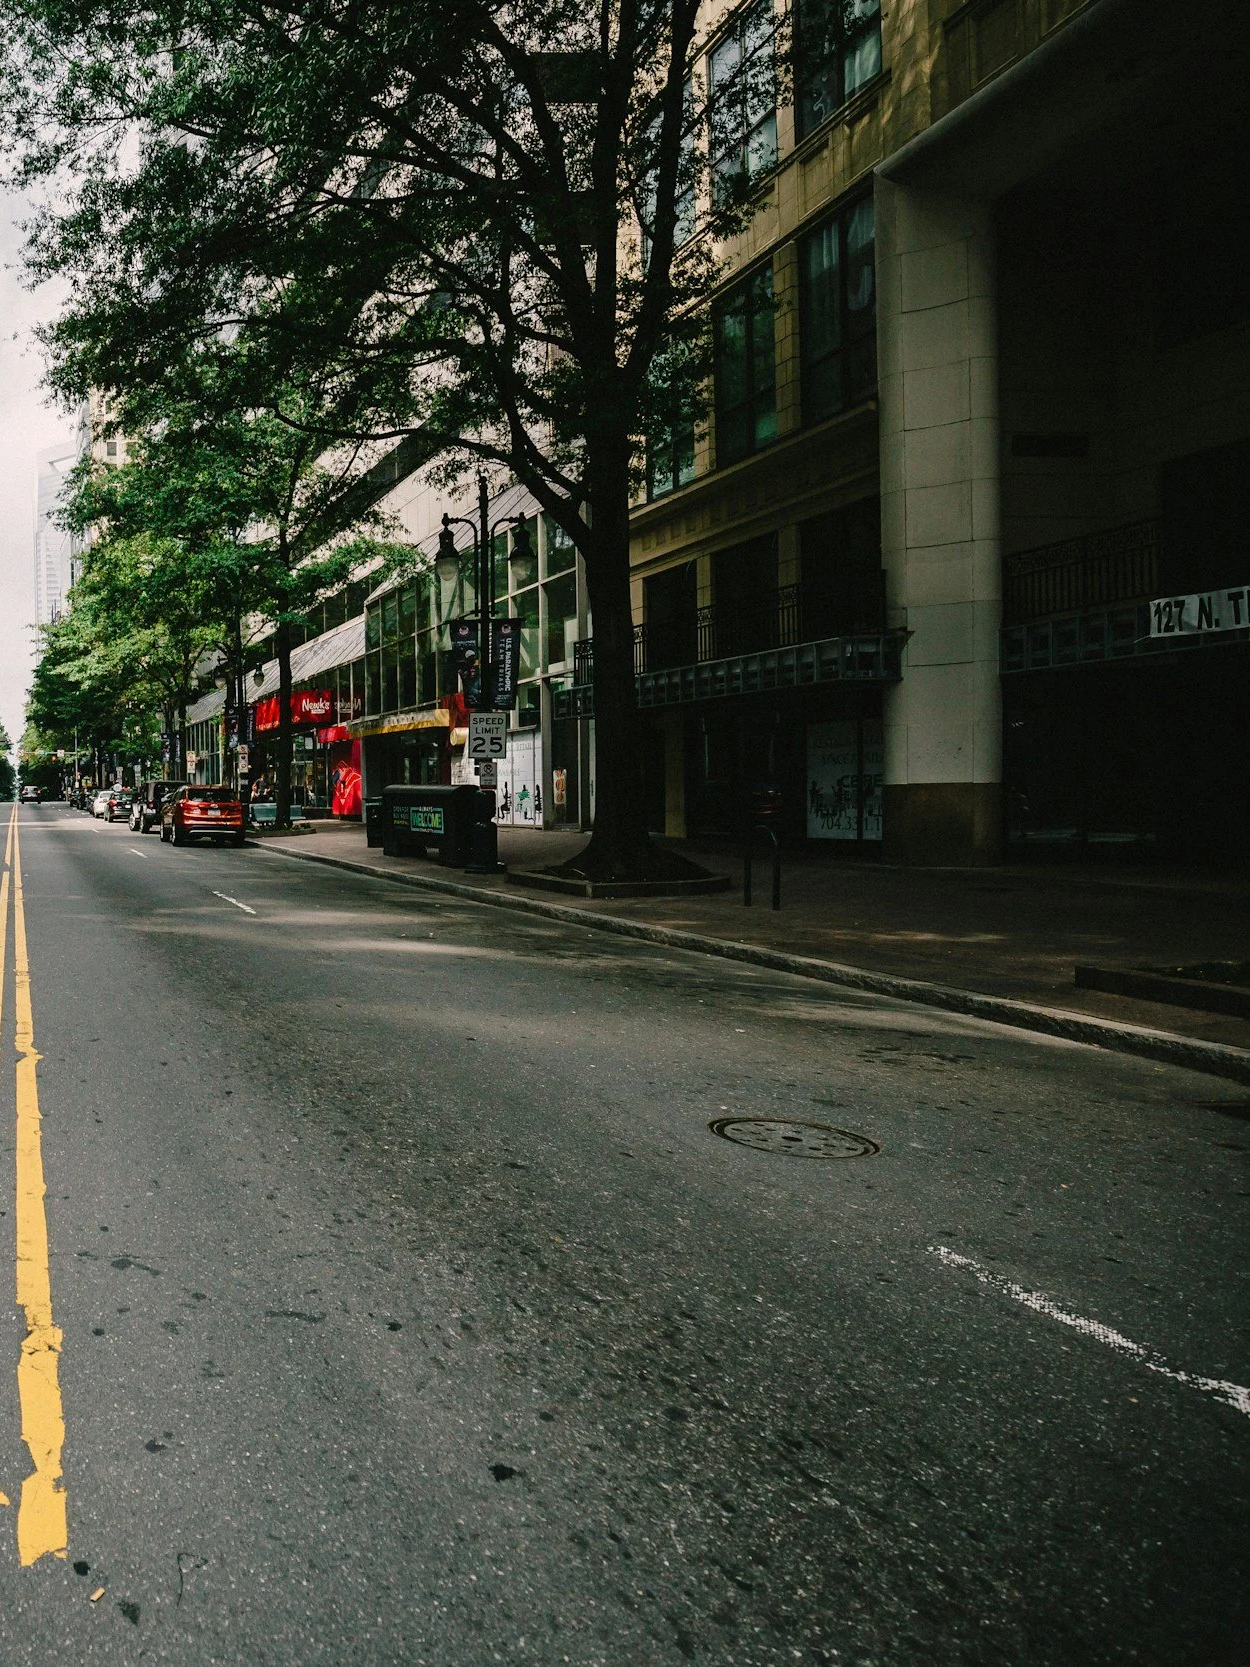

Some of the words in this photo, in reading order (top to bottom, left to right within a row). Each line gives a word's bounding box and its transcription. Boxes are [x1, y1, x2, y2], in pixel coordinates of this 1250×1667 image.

[1154, 600, 1185, 633] 127
[1198, 596, 1220, 630] N.
[1227, 590, 1250, 625] T
[302, 698, 330, 711] Newk's
[472, 717, 504, 725] SPEED
[475, 727, 499, 735] LIMIT
[472, 737, 503, 753] 25
[412, 812, 442, 829] WELCOME
